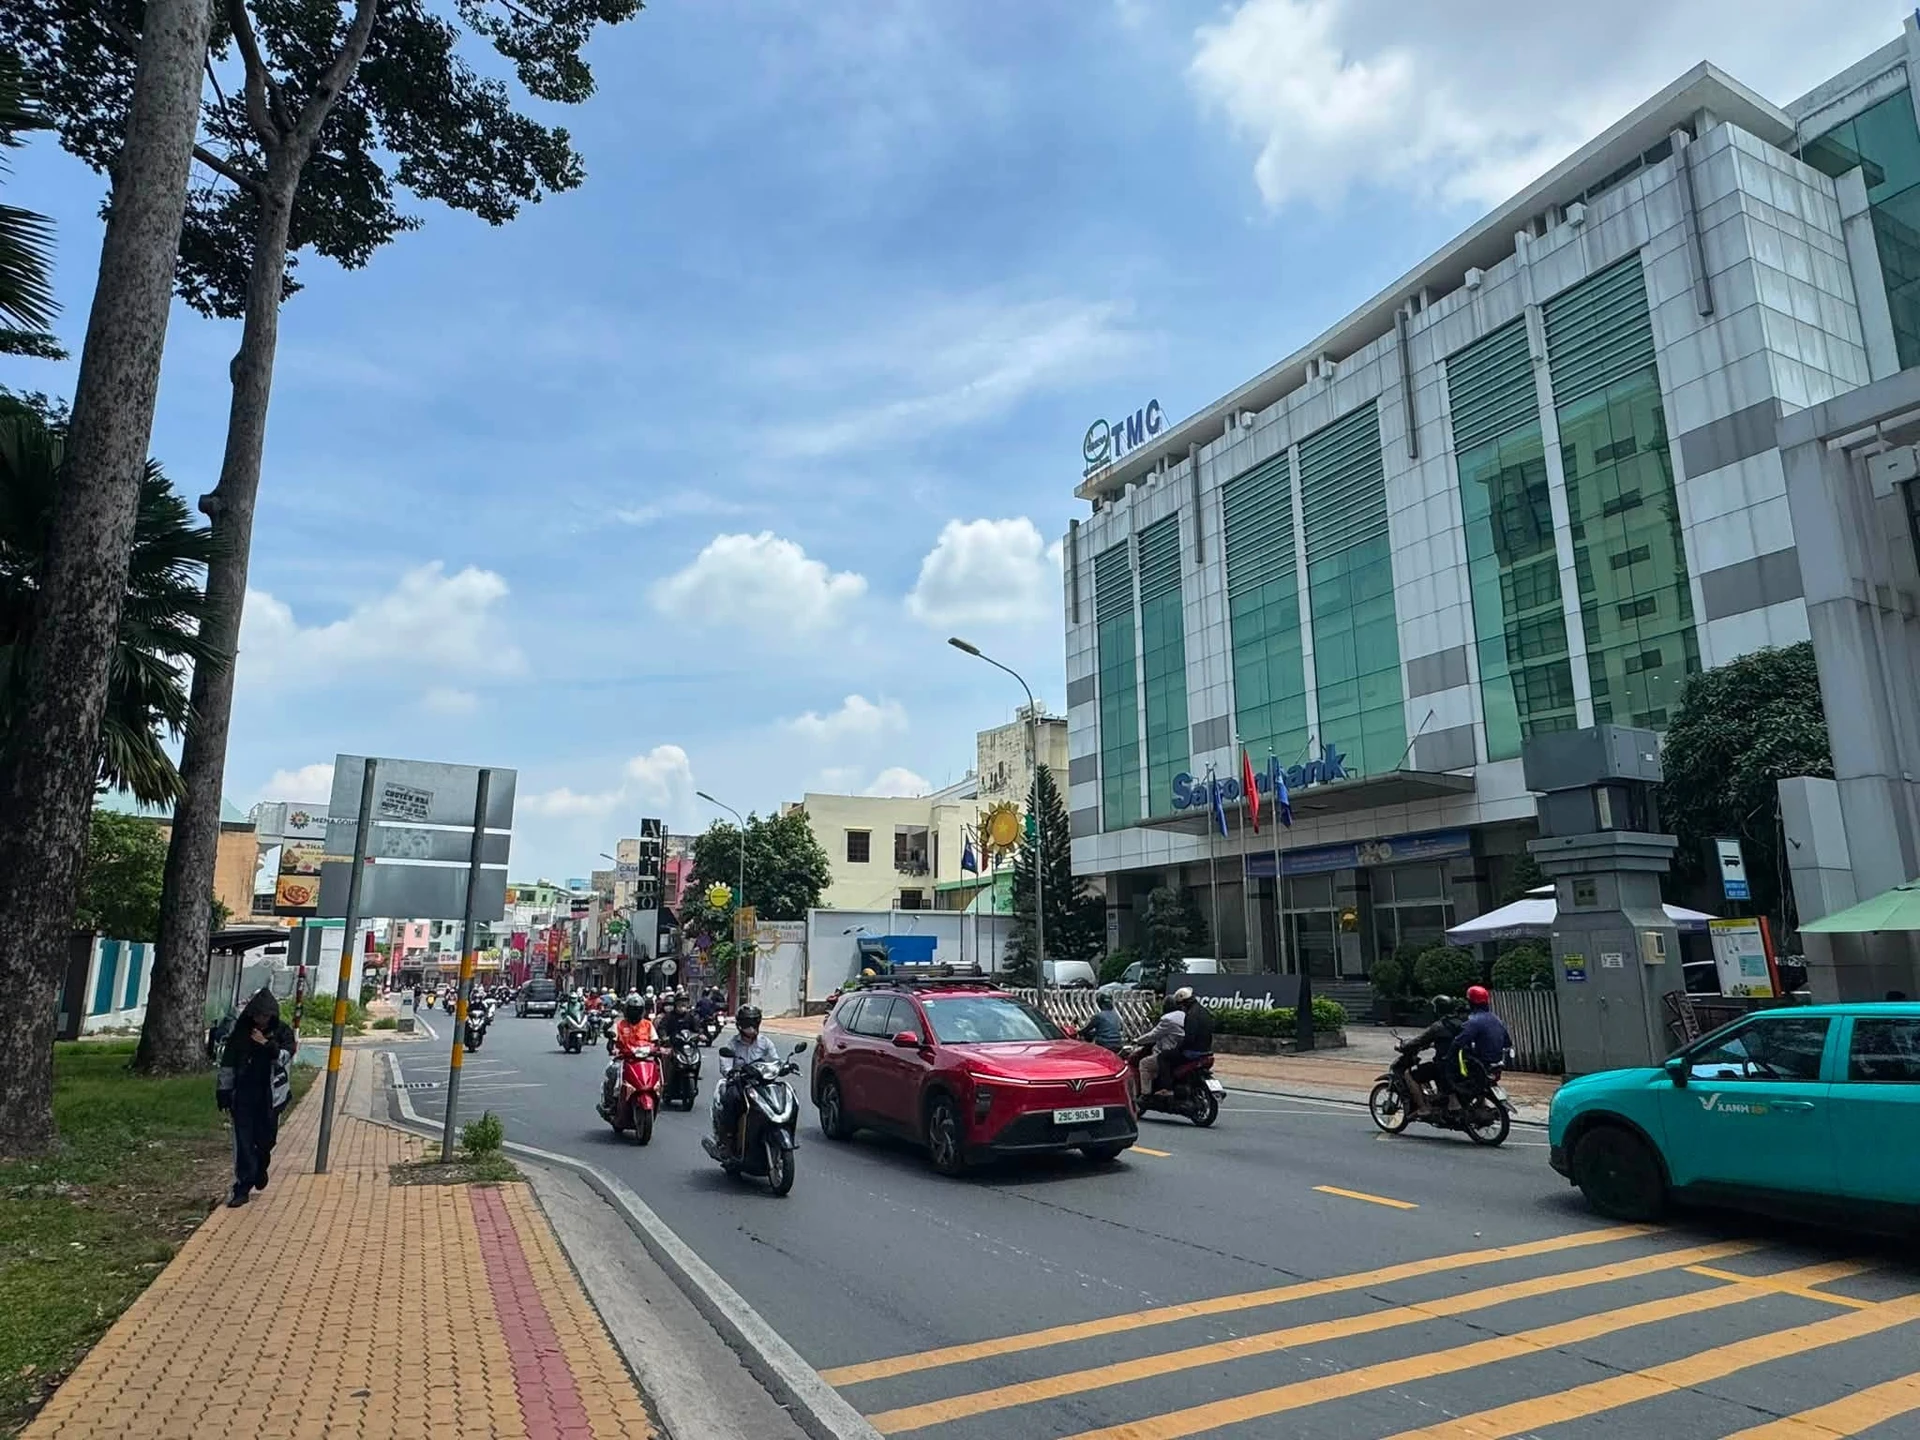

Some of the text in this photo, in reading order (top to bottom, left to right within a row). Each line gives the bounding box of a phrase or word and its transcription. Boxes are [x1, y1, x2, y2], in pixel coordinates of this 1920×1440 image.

[1111, 398, 1161, 457] TMC
[337, 818, 375, 827] GOUT
[641, 819, 659, 909] Atino
